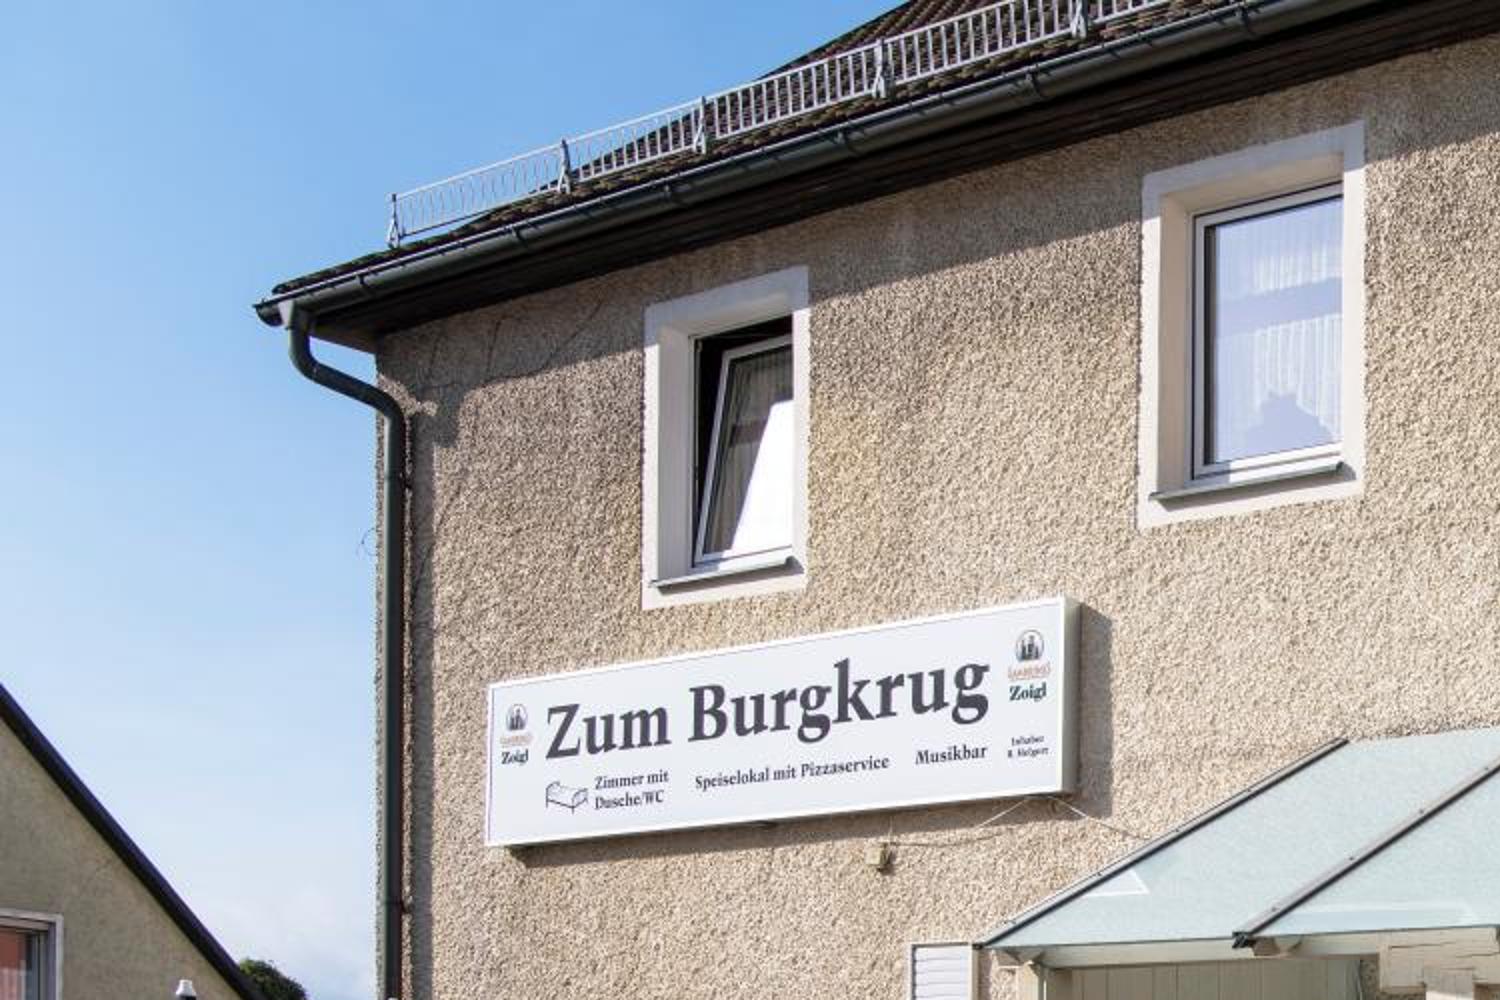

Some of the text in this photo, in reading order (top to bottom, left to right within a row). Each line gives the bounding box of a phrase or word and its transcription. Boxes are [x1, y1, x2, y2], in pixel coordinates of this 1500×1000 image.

[1009, 682, 1047, 702] Zoigl
[546, 658, 990, 759] Zum Burgkrug
[501, 749, 529, 766] Zoigl
[915, 745, 988, 766] Musikbar
[594, 769, 670, 790] Zimmer mit
[695, 755, 889, 791] Speiselokal mit Pizzaservice
[594, 790, 665, 810] Dusche/WC
